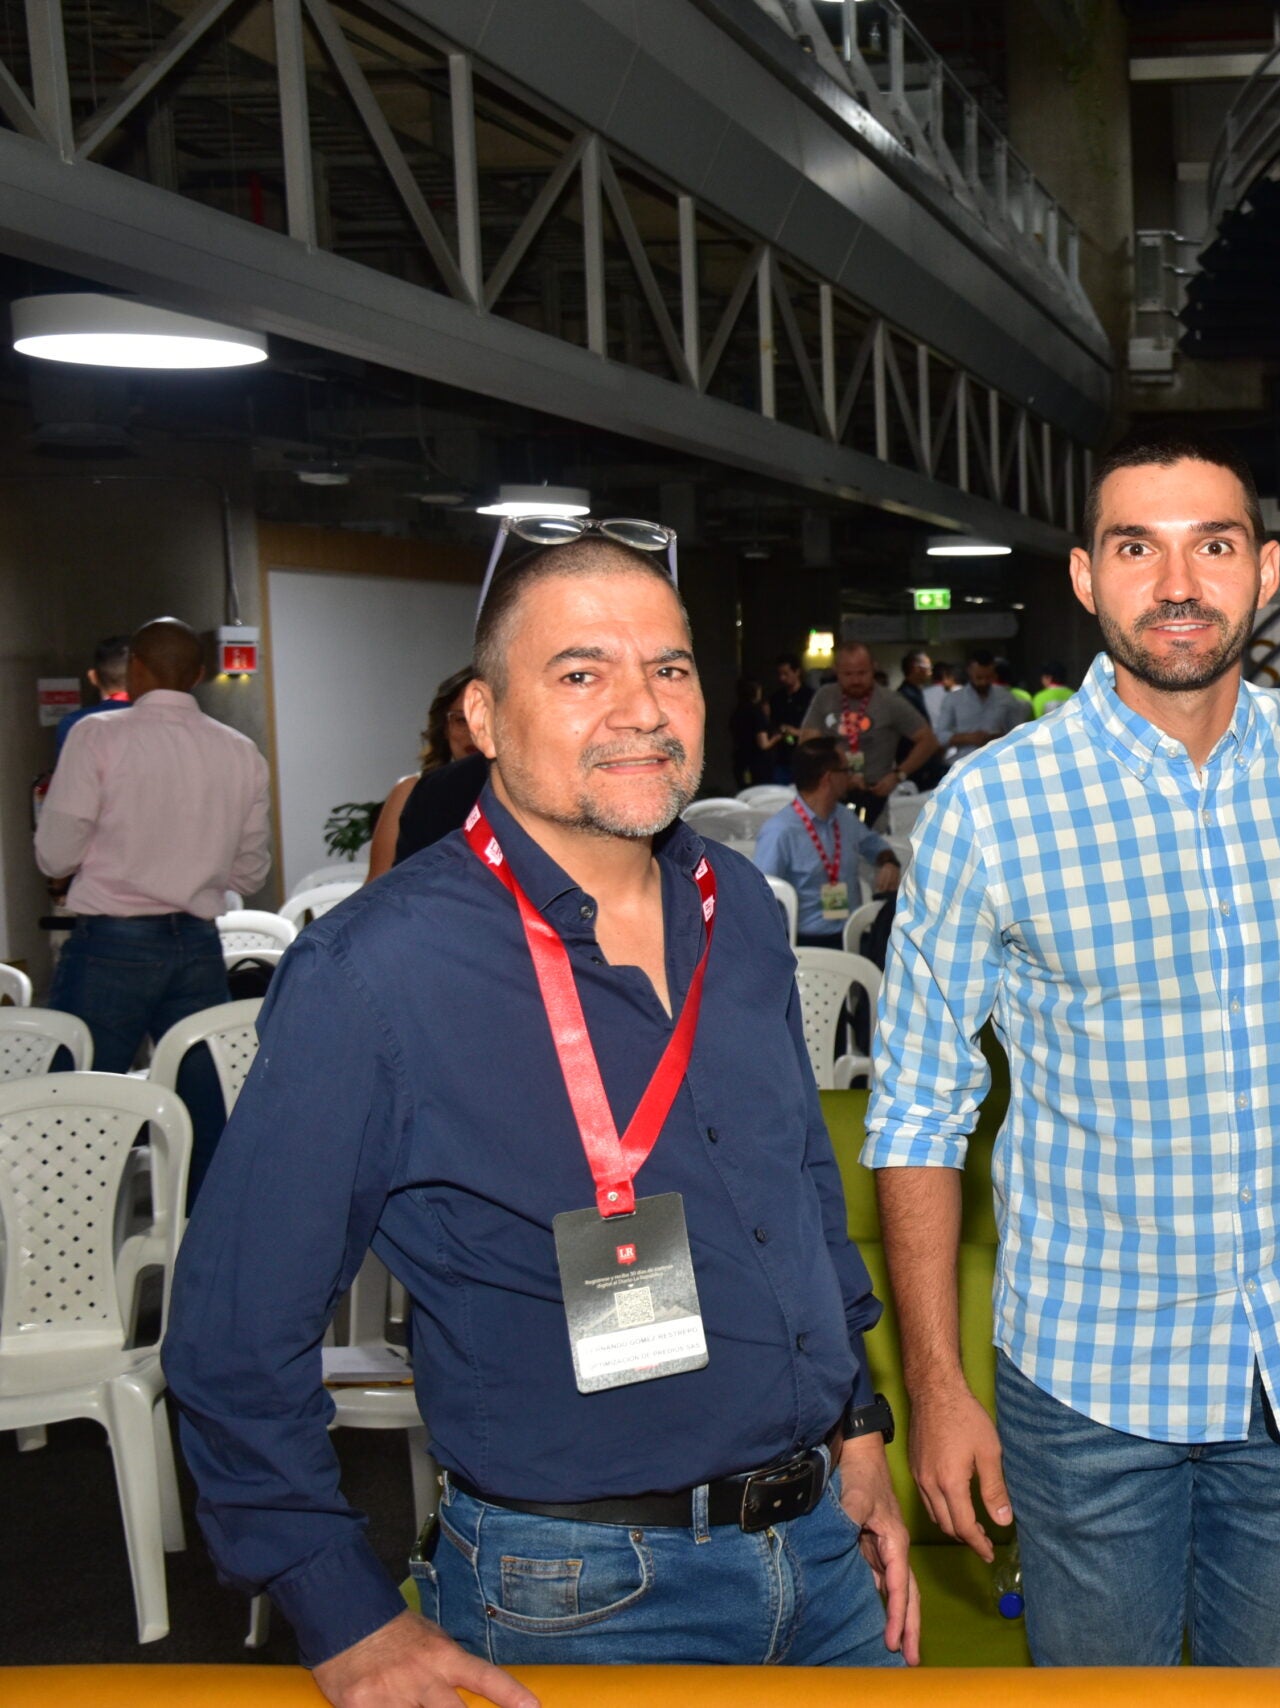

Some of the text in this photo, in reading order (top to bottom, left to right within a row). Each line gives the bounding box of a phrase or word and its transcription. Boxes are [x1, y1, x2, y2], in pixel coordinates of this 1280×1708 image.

[619, 1247, 634, 1258] LR
[629, 1335, 656, 1346] GOMEZ
[658, 1327, 698, 1340] RESTREPO
[653, 1346, 684, 1357] PREDIOS
[686, 1342, 701, 1351] SAS
